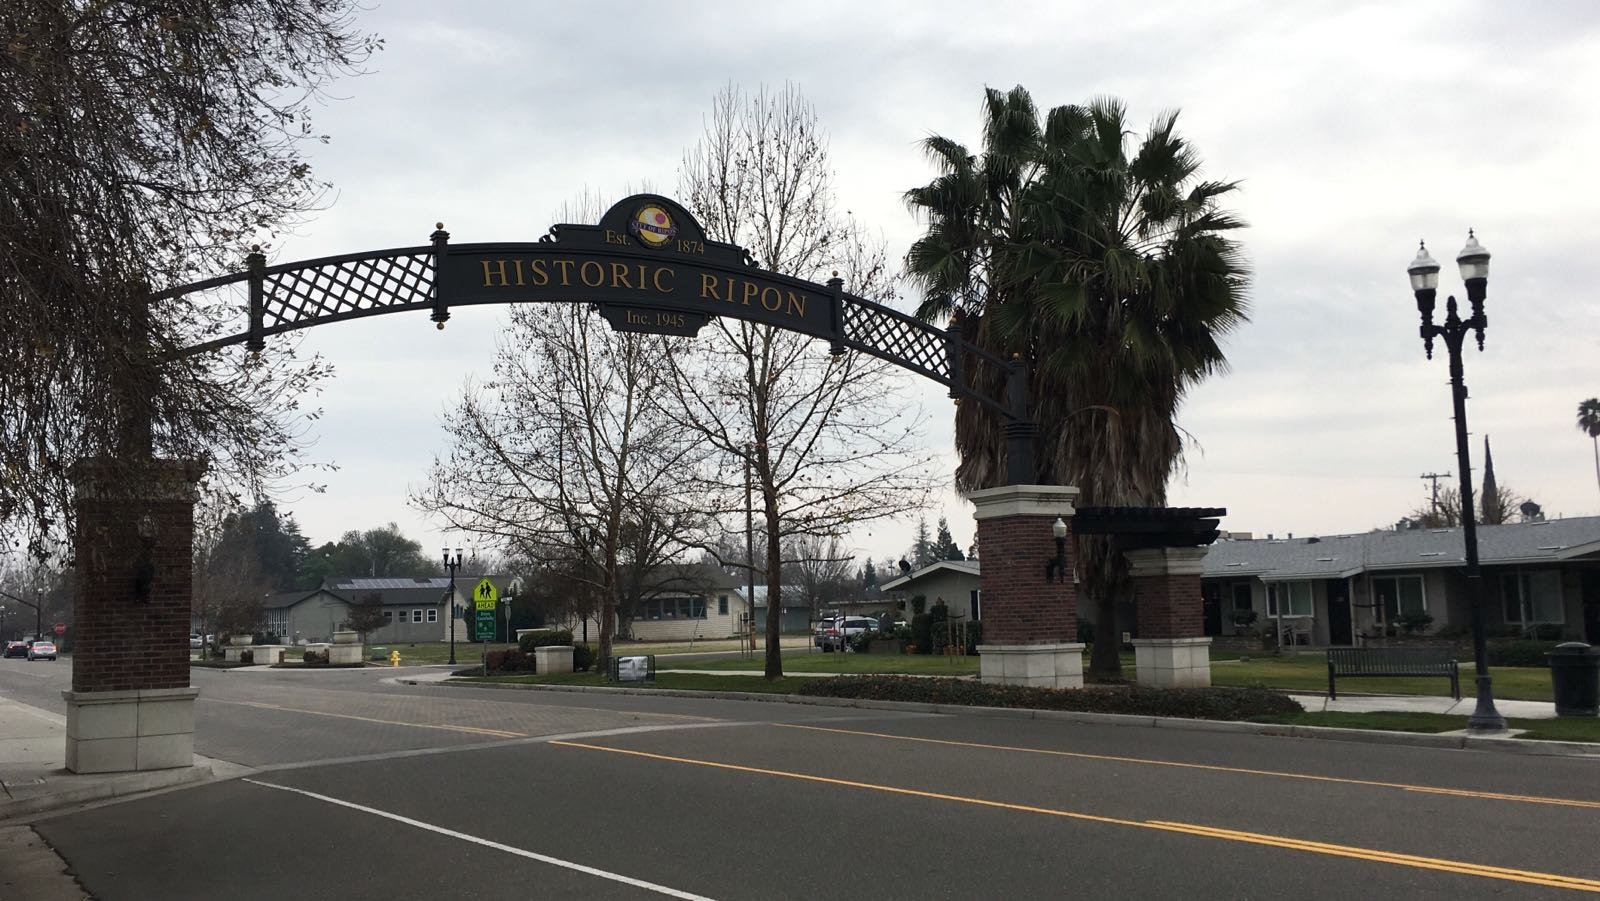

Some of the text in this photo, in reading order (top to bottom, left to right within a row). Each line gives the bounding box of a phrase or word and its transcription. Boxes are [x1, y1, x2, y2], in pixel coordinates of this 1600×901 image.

[605, 229, 631, 246] Est.
[676, 239, 705, 255] 1874
[480, 258, 808, 317] HISTORIC RIPON
[626, 310, 686, 328] Inc. 1945
